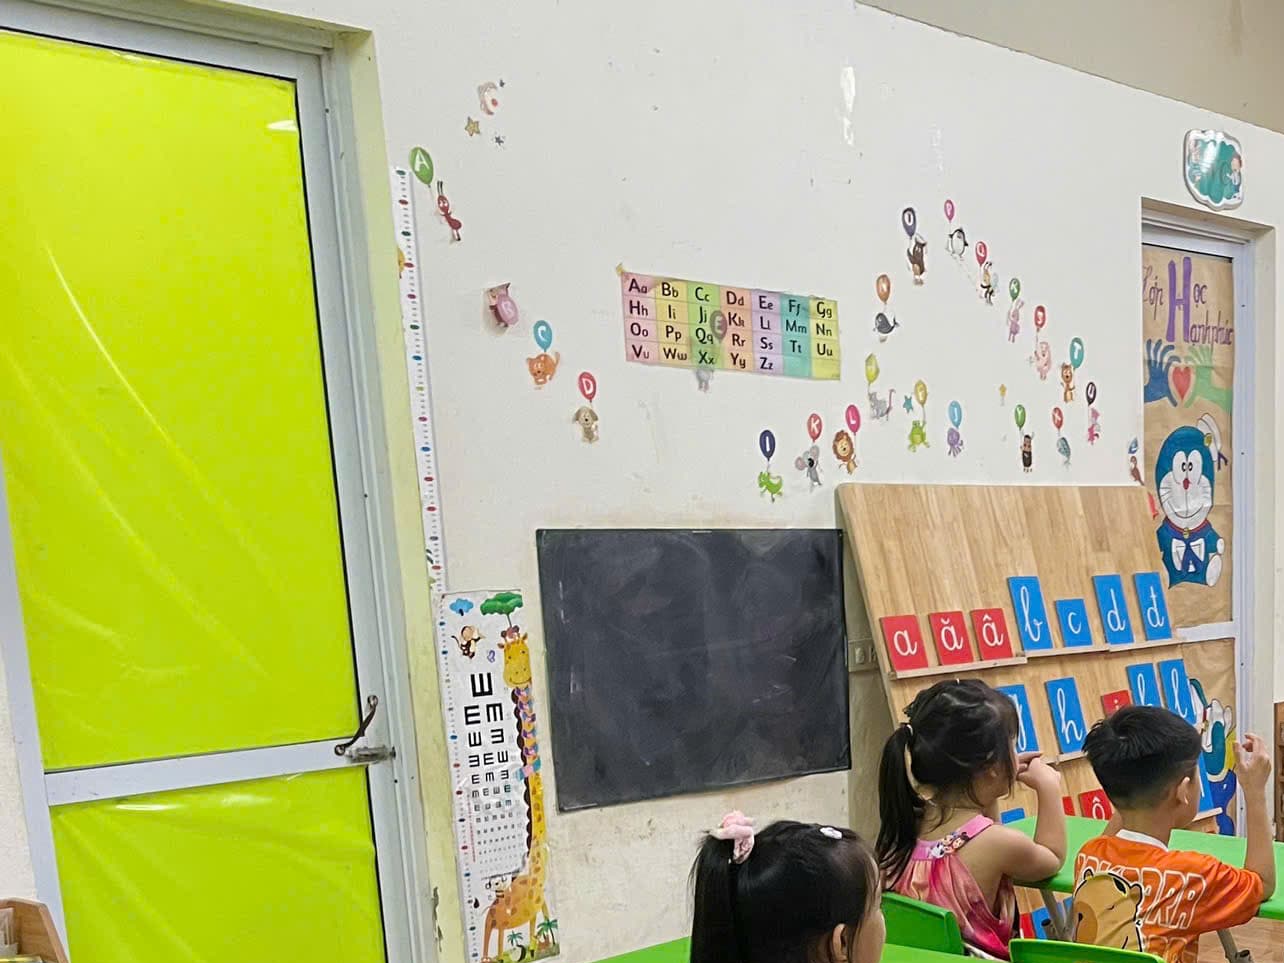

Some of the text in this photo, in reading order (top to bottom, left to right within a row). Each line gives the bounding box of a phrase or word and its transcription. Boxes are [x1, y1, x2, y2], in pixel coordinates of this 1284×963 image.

[414, 149, 430, 171] A
[628, 278, 832, 318] Aa Bb Cc Dd Ee Ff Gg
[629, 300, 648, 316] Hh
[668, 304, 676, 320] Ii
[698, 306, 707, 324] Jj
[785, 320, 807, 333] Mm
[816, 324, 832, 336] Nn
[630, 323, 649, 337] Oo
[665, 325, 682, 342] Pp
[732, 334, 745, 347] Rr
[760, 337, 773, 350] Ss
[789, 340, 802, 353] Tt
[817, 343, 832, 356] Uu
[663, 347, 687, 360] Ww
[698, 351, 714, 364] Xx
[730, 352, 746, 369] Yy
[760, 357, 773, 370] Zz
[581, 377, 593, 395] D
[893, 585, 1165, 656] a ă â b c d đ
[1057, 687, 1083, 744] h
